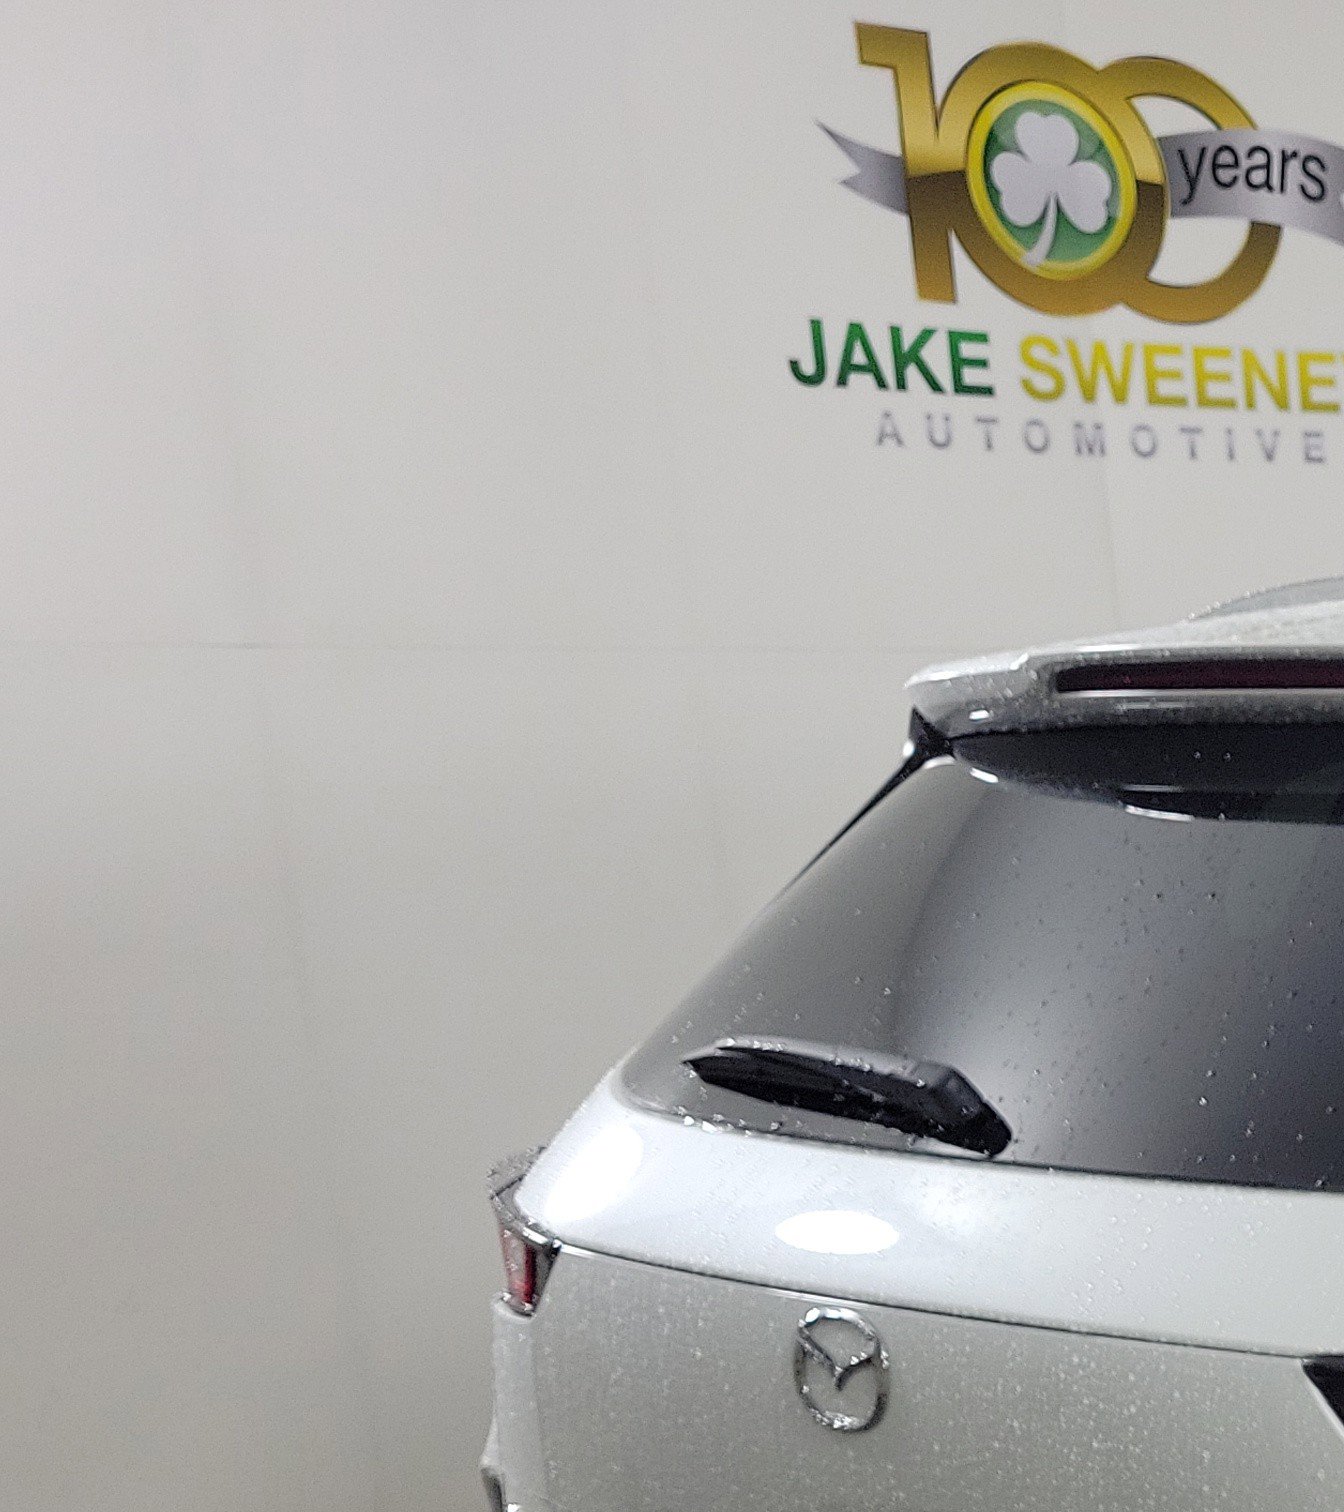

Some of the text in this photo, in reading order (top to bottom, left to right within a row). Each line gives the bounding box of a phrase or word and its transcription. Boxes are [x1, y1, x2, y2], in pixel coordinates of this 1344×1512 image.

[853, 19, 1328, 325] 100 years
[788, 318, 996, 398] JAKE
[874, 410, 1329, 466] AUTOMOTIVE
